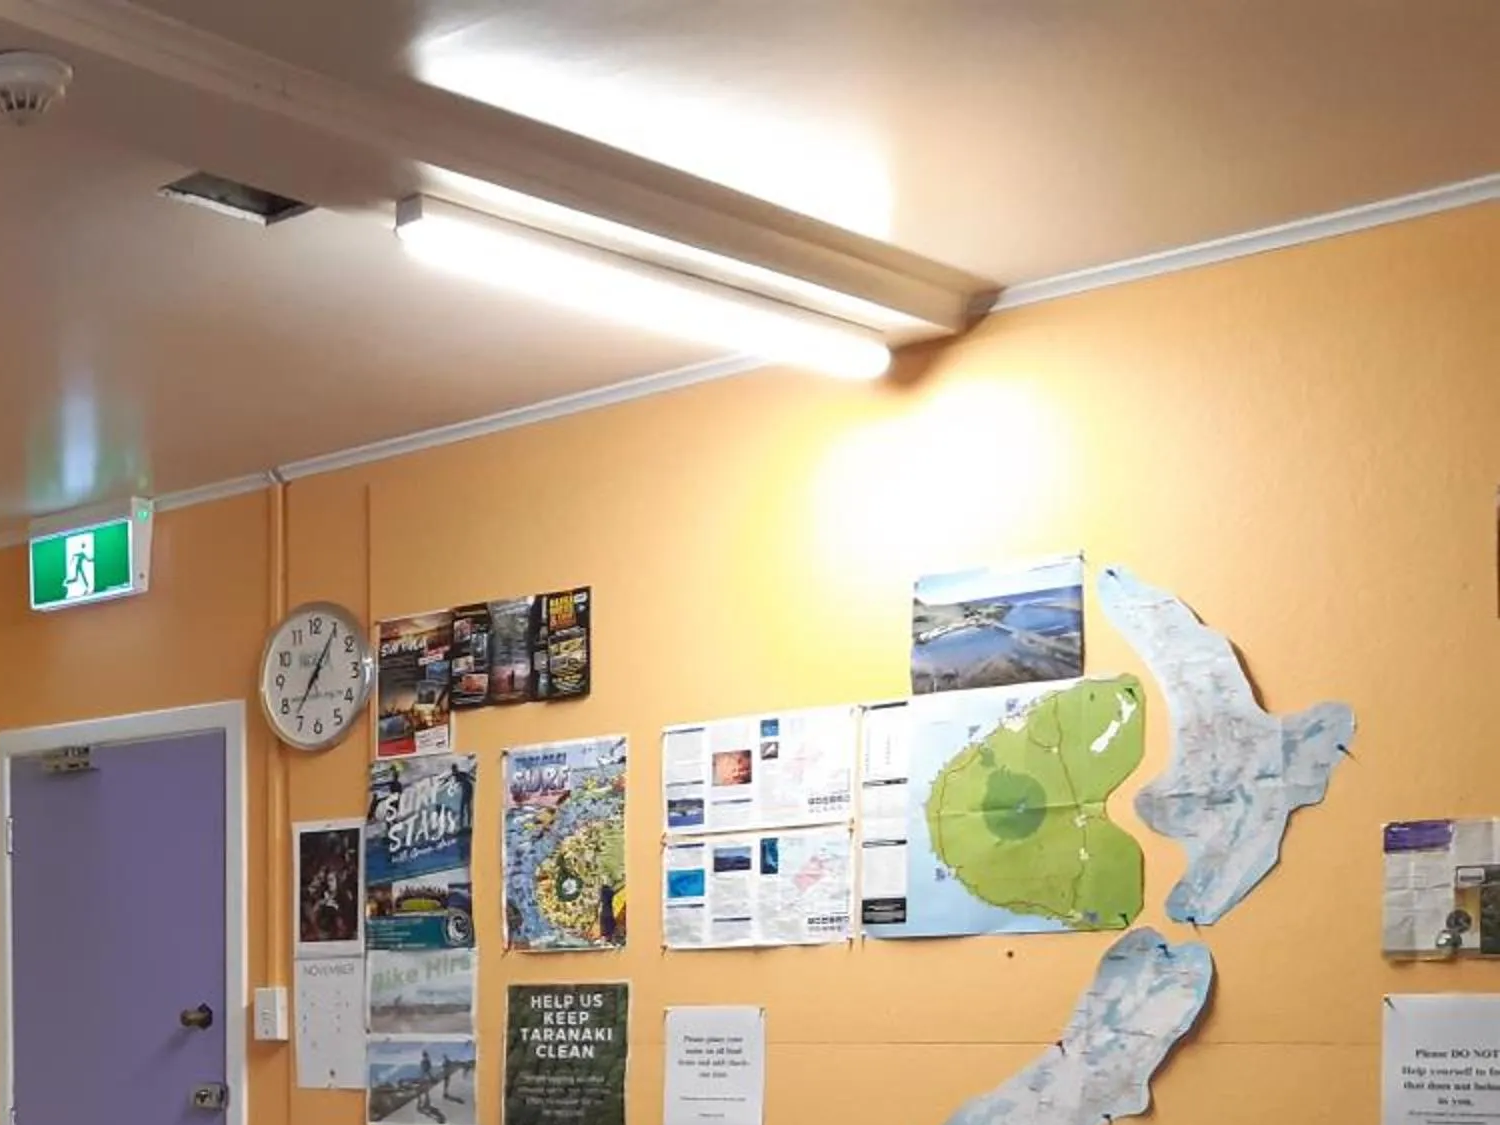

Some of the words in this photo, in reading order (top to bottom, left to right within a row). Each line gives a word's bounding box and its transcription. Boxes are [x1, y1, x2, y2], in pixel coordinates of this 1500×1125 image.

[308, 617, 323, 635] 12
[292, 630, 303, 646] 11
[344, 635, 355, 653] 2
[278, 652, 291, 667] 10
[351, 662, 360, 679] 3
[276, 674, 285, 691] 9
[344, 687, 353, 704] 4
[281, 698, 290, 715] 8
[296, 715, 304, 732] 7
[333, 708, 343, 725] 5
[313, 718, 323, 735] 6
[303, 963, 355, 977] NOVEMBER
[530, 994, 574, 1009] HELP
[580, 993, 603, 1009] US
[543, 1011, 589, 1025] KEEP
[520, 1027, 613, 1041] TARANAKI
[535, 1044, 595, 1058] CLEAN
[1415, 1048, 1448, 1059] Please
[1451, 1049, 1471, 1058] DO
[1474, 1049, 1500, 1059] NOT
[1402, 1066, 1427, 1077] Help
[1430, 1066, 1473, 1077] yourself
